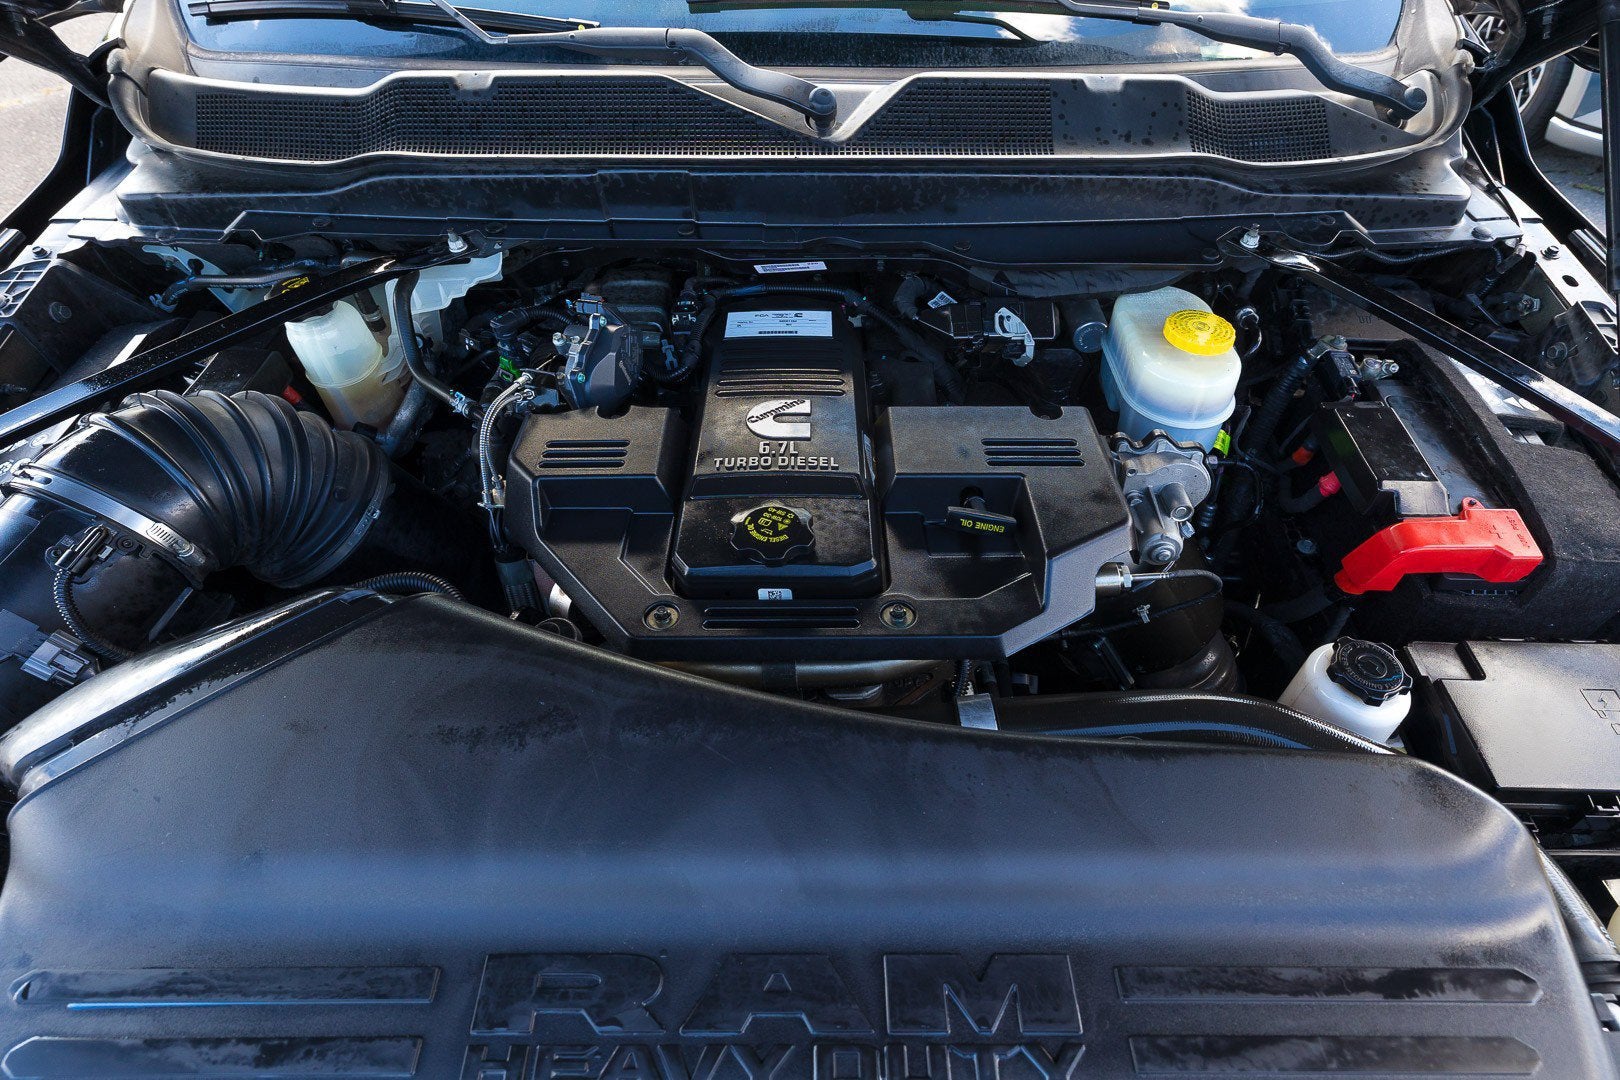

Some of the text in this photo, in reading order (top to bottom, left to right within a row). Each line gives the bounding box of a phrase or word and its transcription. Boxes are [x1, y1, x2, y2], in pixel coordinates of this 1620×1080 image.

[747, 399, 806, 423] Cummins
[758, 440, 799, 456] 6.7L
[714, 456, 839, 470] TURBO DIESEL
[960, 518, 1005, 533] ENGINE OIL
[470, 953, 1083, 1035] RAM
[458, 1044, 1086, 1080] HEAVY DUTY
